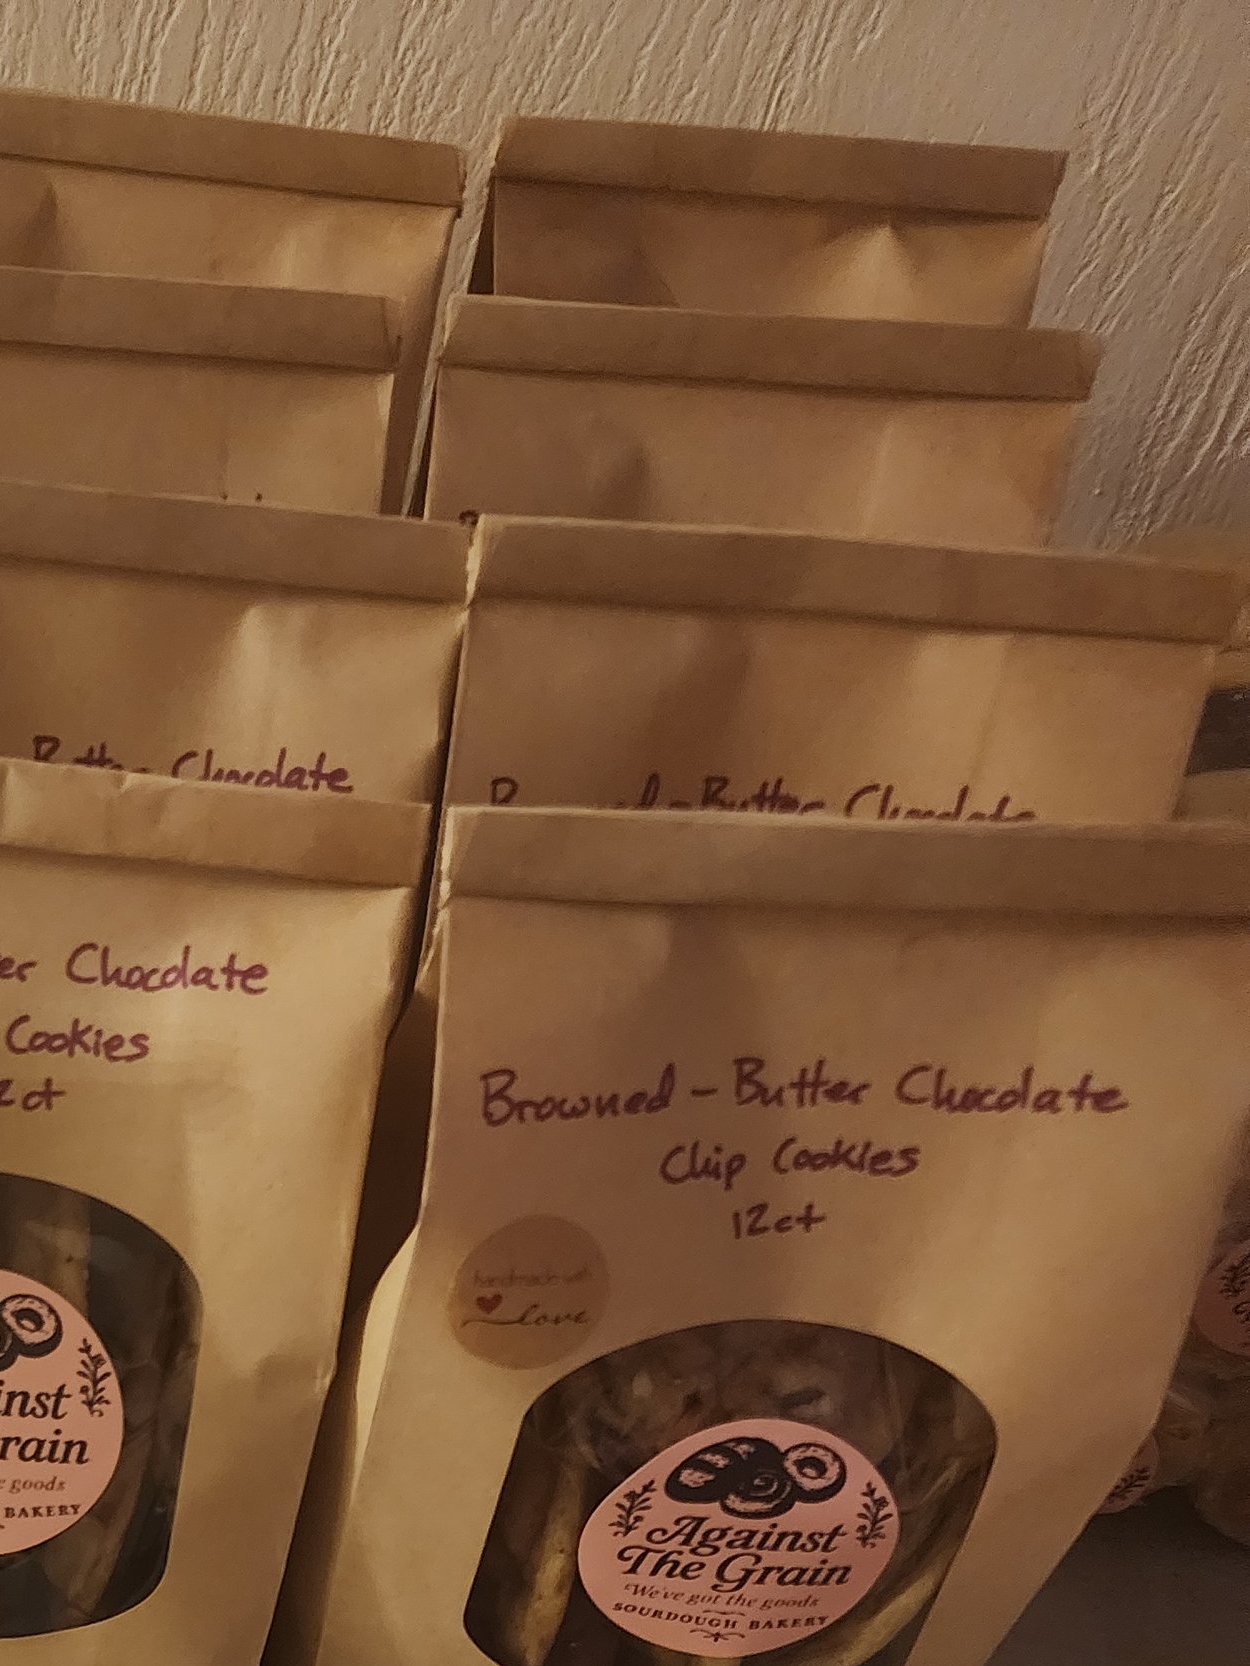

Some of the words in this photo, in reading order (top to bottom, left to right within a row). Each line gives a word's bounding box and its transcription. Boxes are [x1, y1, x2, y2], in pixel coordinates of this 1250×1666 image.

[65, 942, 270, 996] Chocolate
[4, 1014, 151, 1063] Cookies
[895, 1063, 1130, 1116] Chocolate
[659, 1139, 747, 1190] Chip
[772, 1136, 921, 1178] Cookies
[8, 1475, 67, 1494] goods
[4, 1503, 82, 1519] BAKERY
[645, 1515, 848, 1557] Against
[616, 1544, 707, 1581] The
[711, 1552, 853, 1594] Grain
[612, 1602, 738, 1630] SOURDOUGH
[748, 1615, 829, 1631] BAKERY
